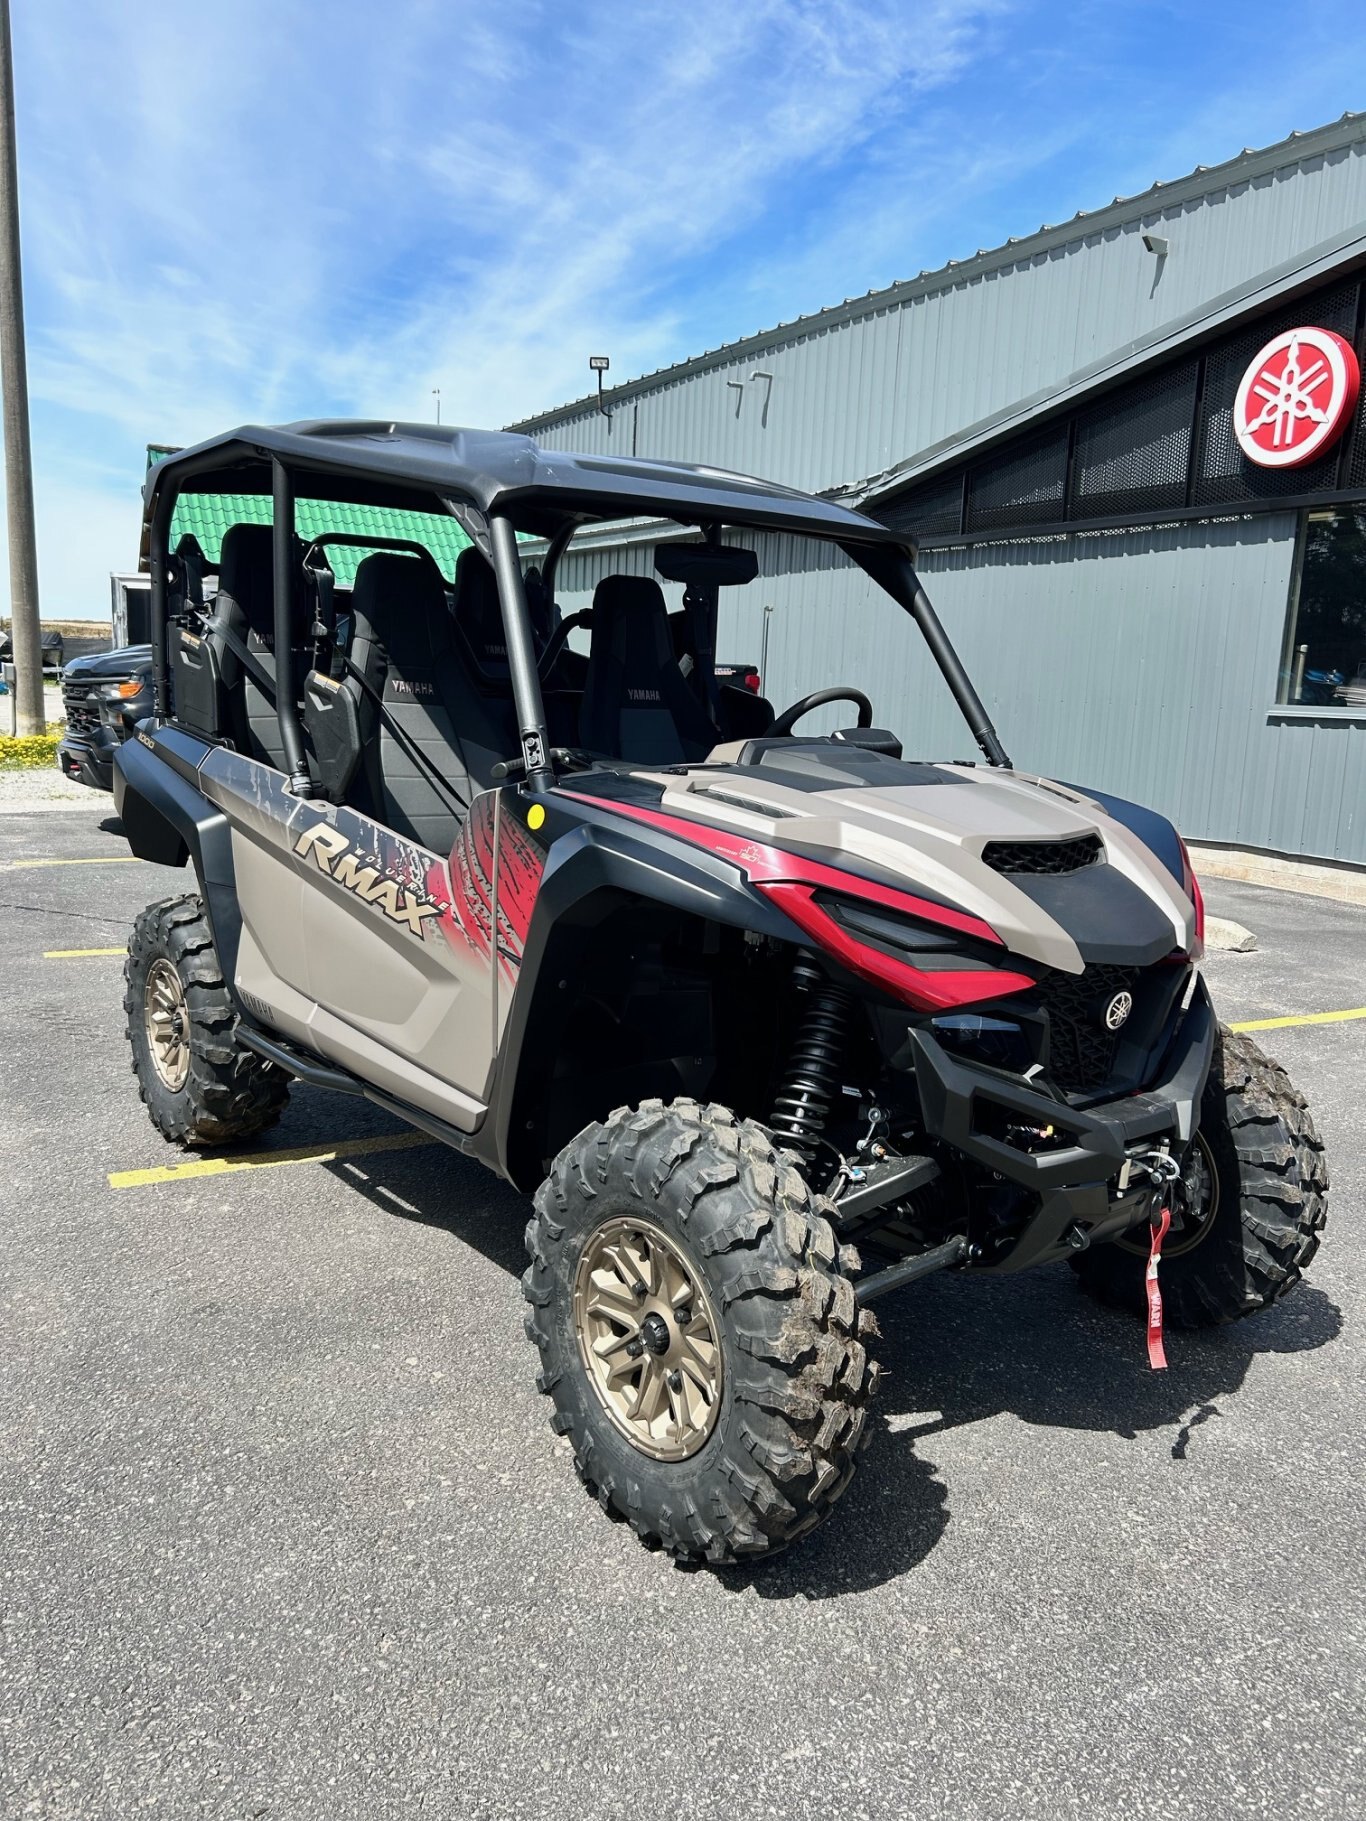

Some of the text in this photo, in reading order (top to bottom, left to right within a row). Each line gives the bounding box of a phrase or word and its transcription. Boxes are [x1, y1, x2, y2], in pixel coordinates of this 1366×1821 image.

[253, 632, 275, 645] YAM
[484, 644, 507, 656] YAMA
[391, 679, 435, 695] YAMAHA
[627, 688, 661, 701] YAMAHA
[138, 732, 155, 749] 1000
[293, 821, 442, 939] RMAX
[354, 847, 450, 911] WOLVERINE
[239, 990, 276, 1024] YAMAHA
[1150, 1294, 1161, 1328] WARN
